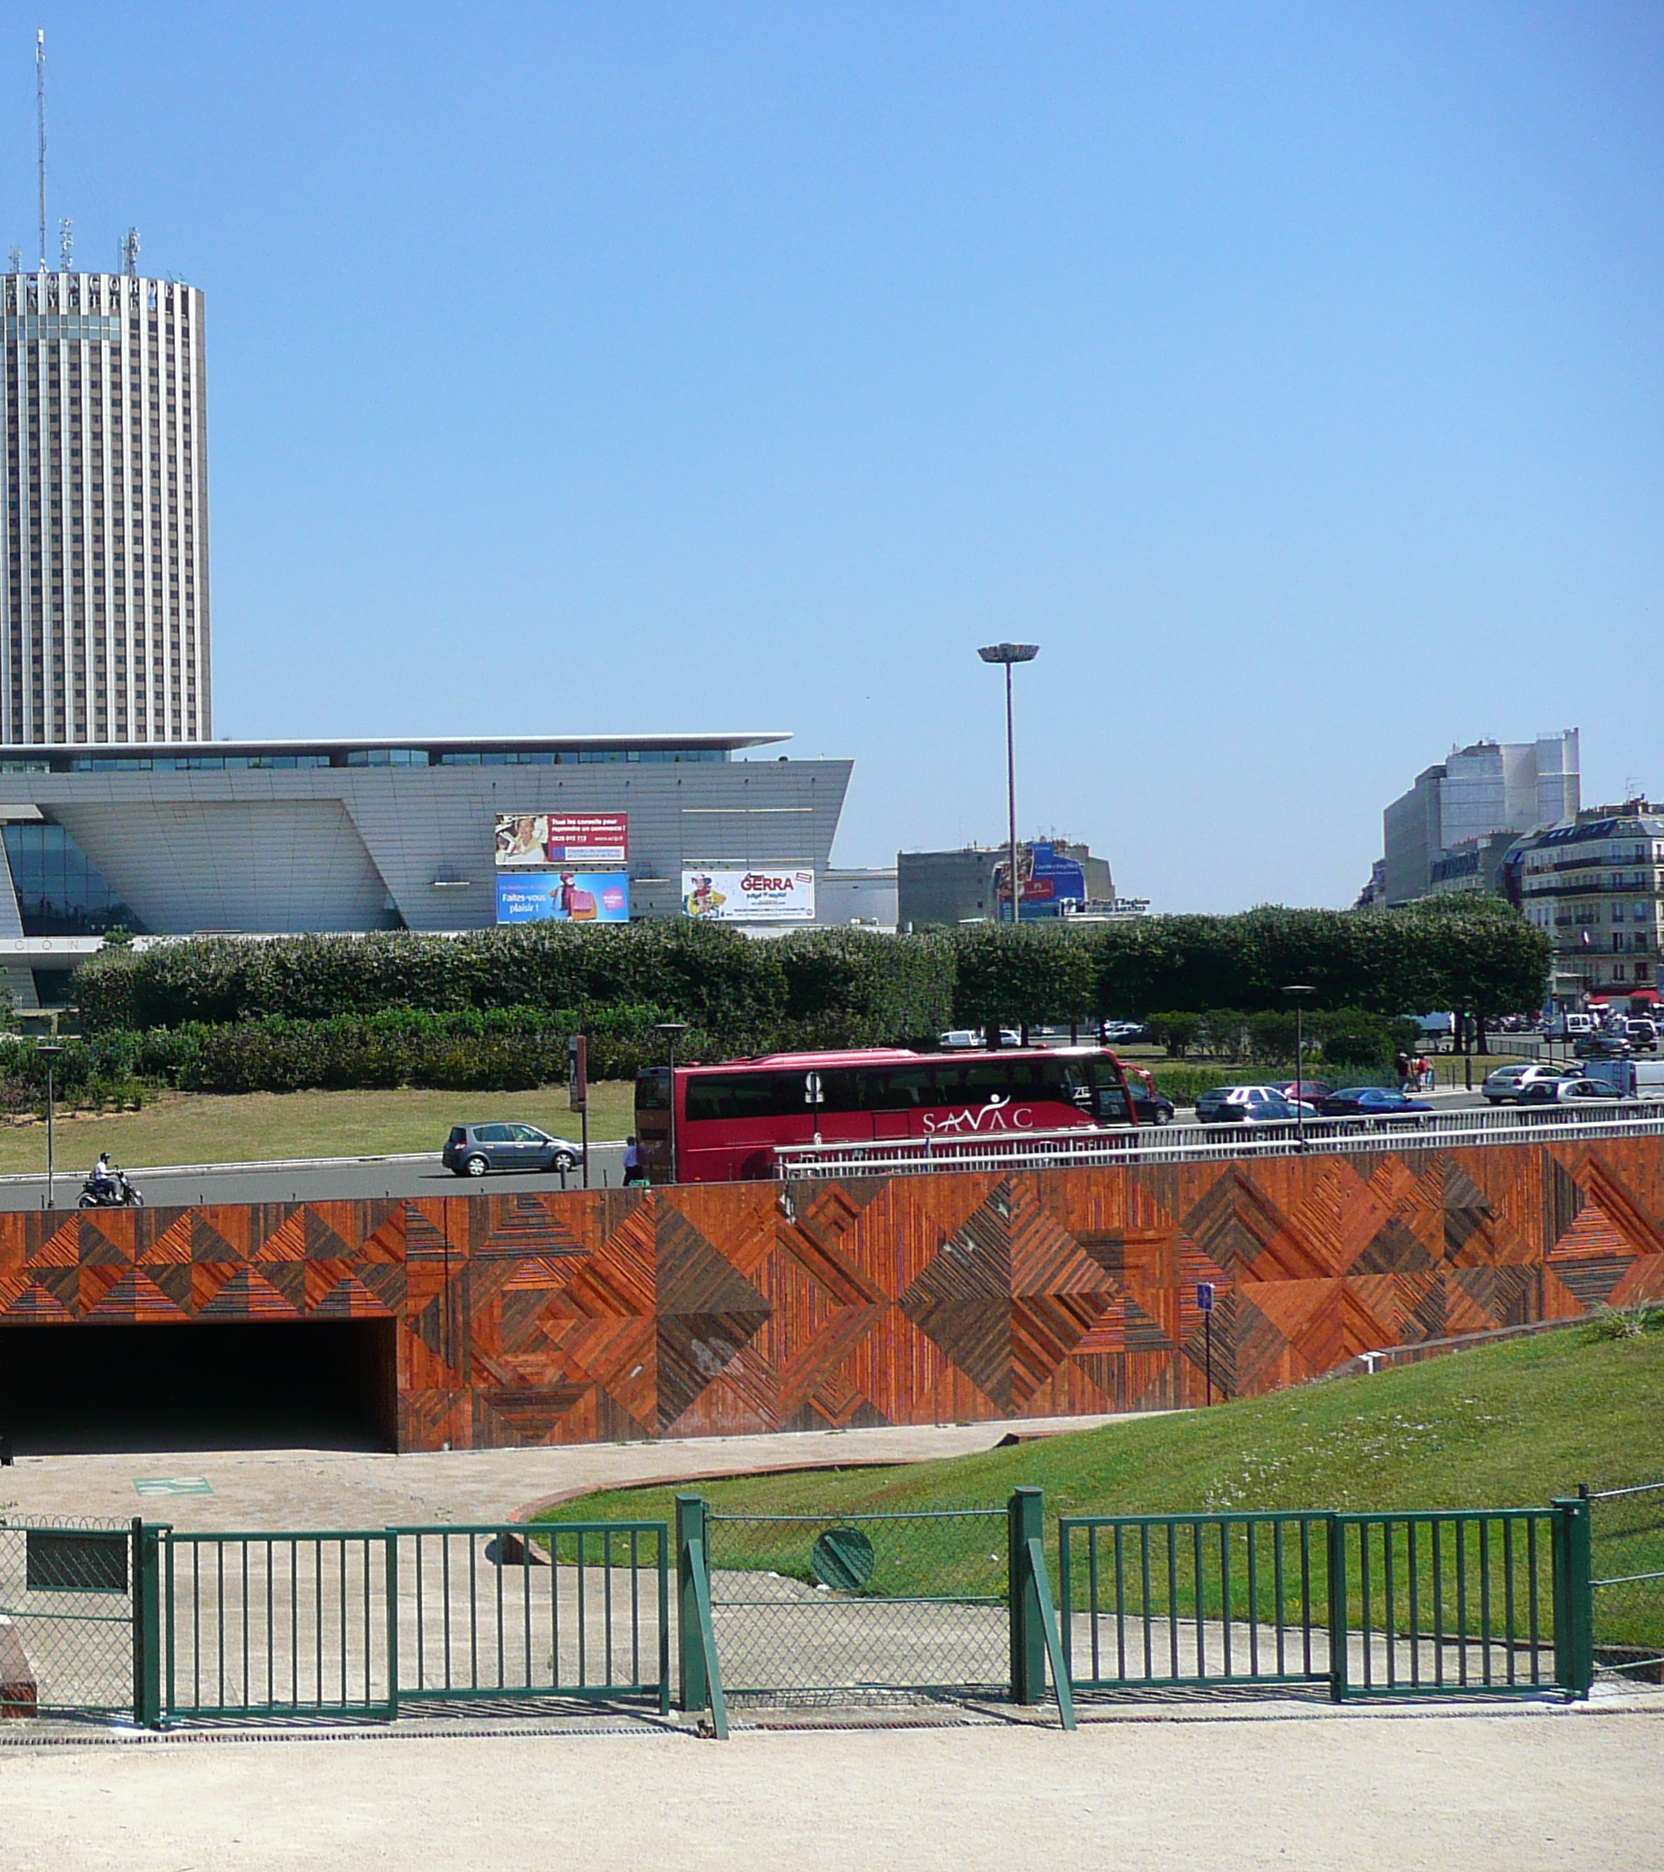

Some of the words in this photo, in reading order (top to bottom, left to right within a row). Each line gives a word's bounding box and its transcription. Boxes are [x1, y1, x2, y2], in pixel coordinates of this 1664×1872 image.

[741, 878, 793, 891] GERRA
[502, 893, 546, 902] Faites-vous
[509, 903, 534, 914] plaisir
[923, 1097, 1034, 1133] SAVAC
